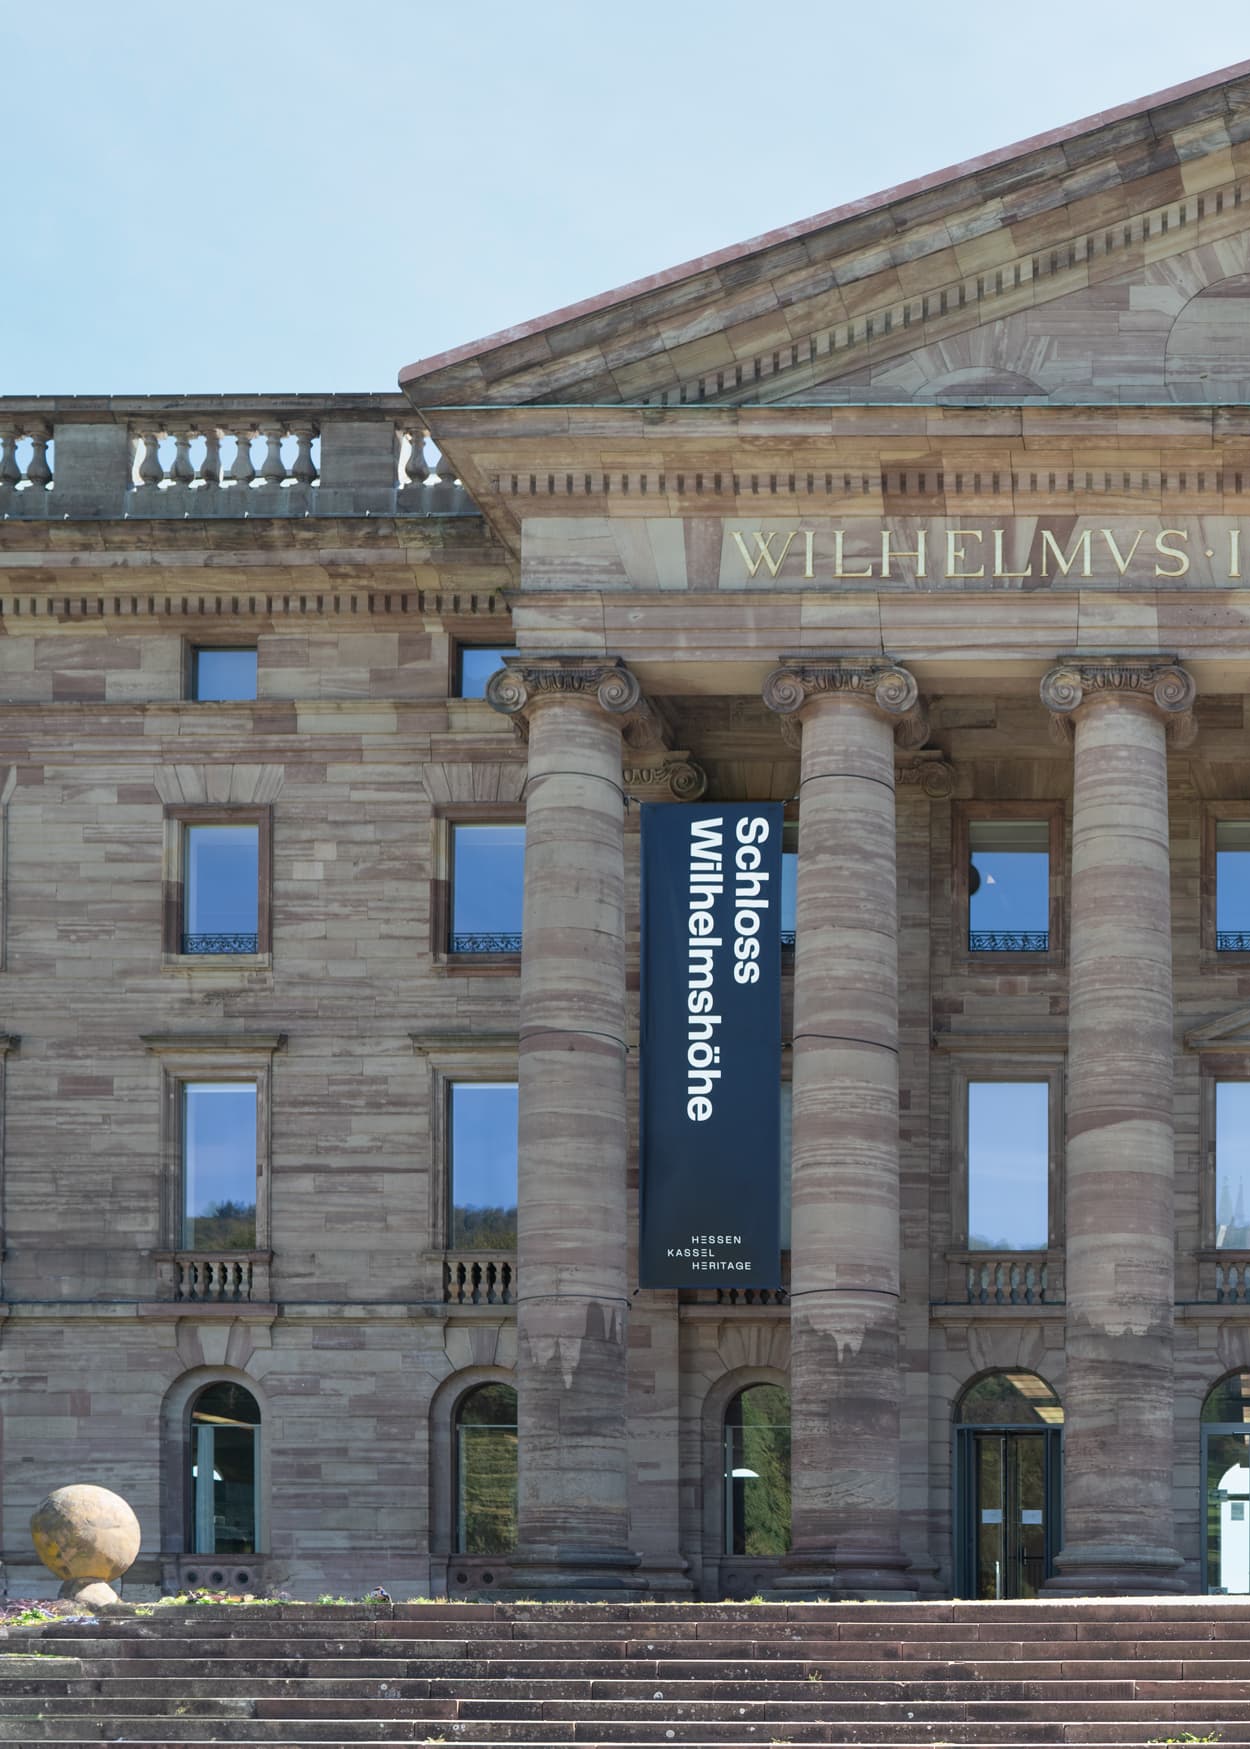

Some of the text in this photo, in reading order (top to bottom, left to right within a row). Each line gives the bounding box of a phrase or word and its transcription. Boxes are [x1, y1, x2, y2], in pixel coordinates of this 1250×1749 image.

[733, 816, 770, 985] Schloss
[686, 817, 724, 1122] Wilhelmshöhe
[691, 1235, 742, 1245] HESSEN
[667, 1248, 715, 1258] KASSEL
[692, 1261, 752, 1271] HERITAGE
